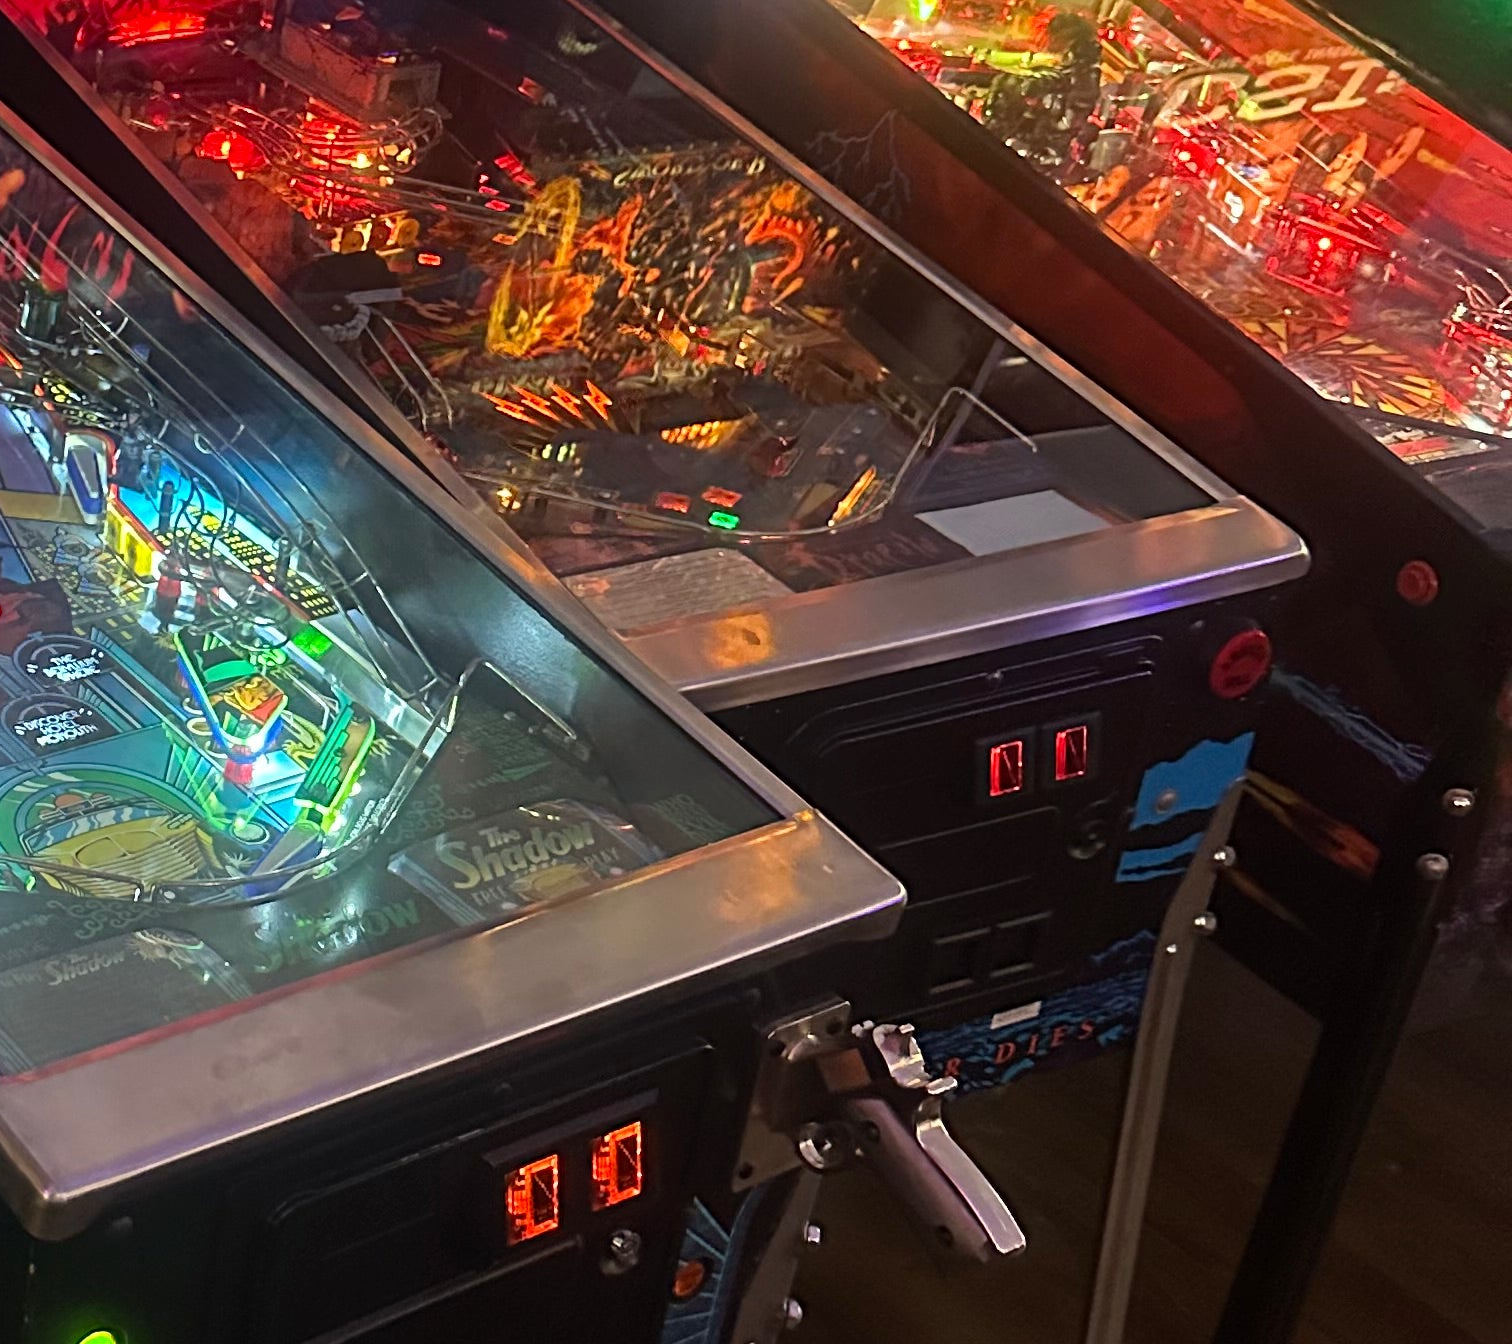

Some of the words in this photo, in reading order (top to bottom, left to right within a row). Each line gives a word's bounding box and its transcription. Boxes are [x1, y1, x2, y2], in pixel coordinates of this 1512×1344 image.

[438, 820, 596, 889] Shadow
[478, 825, 522, 849] The
[993, 1019, 1097, 1066] DIES
